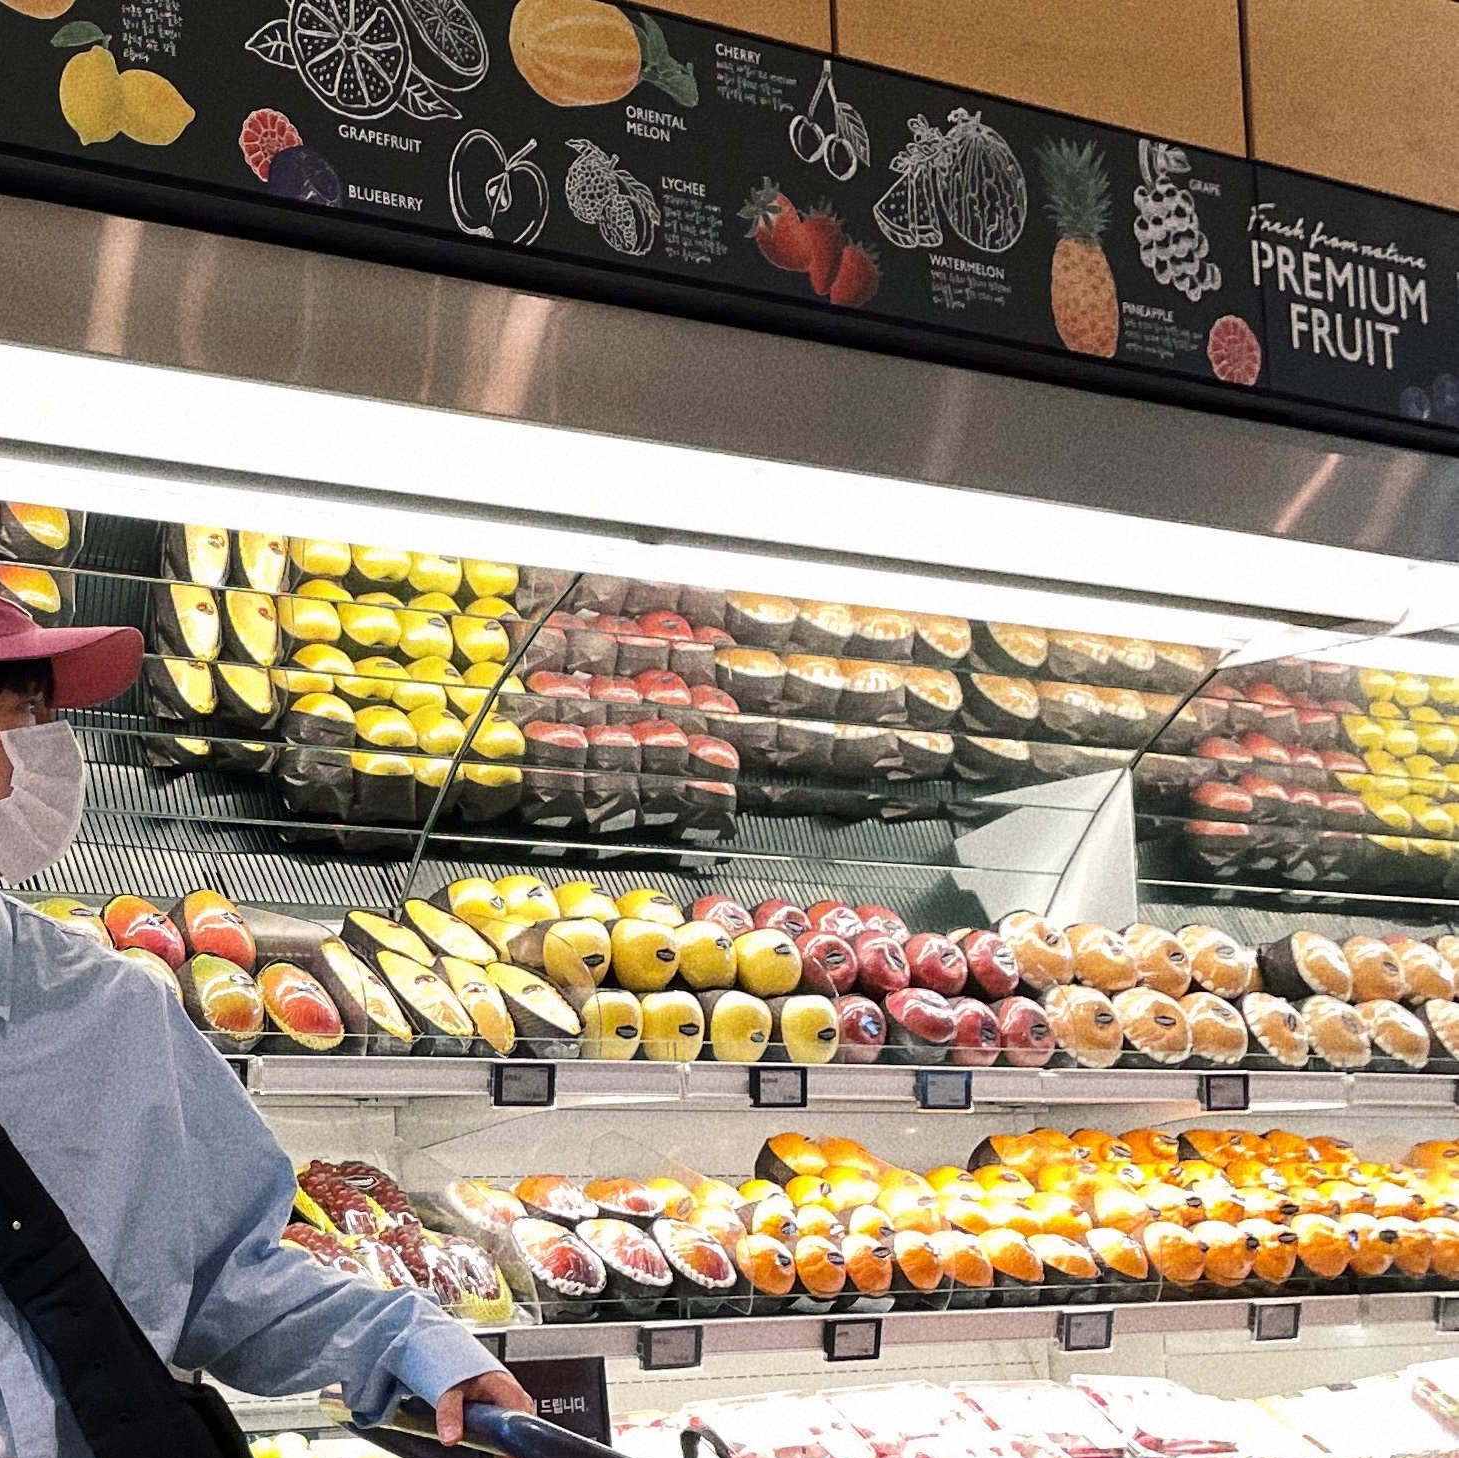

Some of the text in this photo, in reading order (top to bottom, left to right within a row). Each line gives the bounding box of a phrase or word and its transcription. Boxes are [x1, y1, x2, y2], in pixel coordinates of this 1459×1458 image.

[715, 42, 761, 65] CHERRY
[625, 105, 688, 131] ORIENTAL
[626, 121, 671, 142] MELON
[338, 123, 422, 155] GRAPEFRUIT
[347, 184, 424, 212] BLUEBERRY
[661, 175, 706, 197] LYCHEE
[928, 252, 1005, 280] WATERMELON
[1250, 239, 1429, 325] PREMIUM
[1290, 302, 1400, 371] FRUIT
[540, 1396, 591, 1415] 드립니다.
